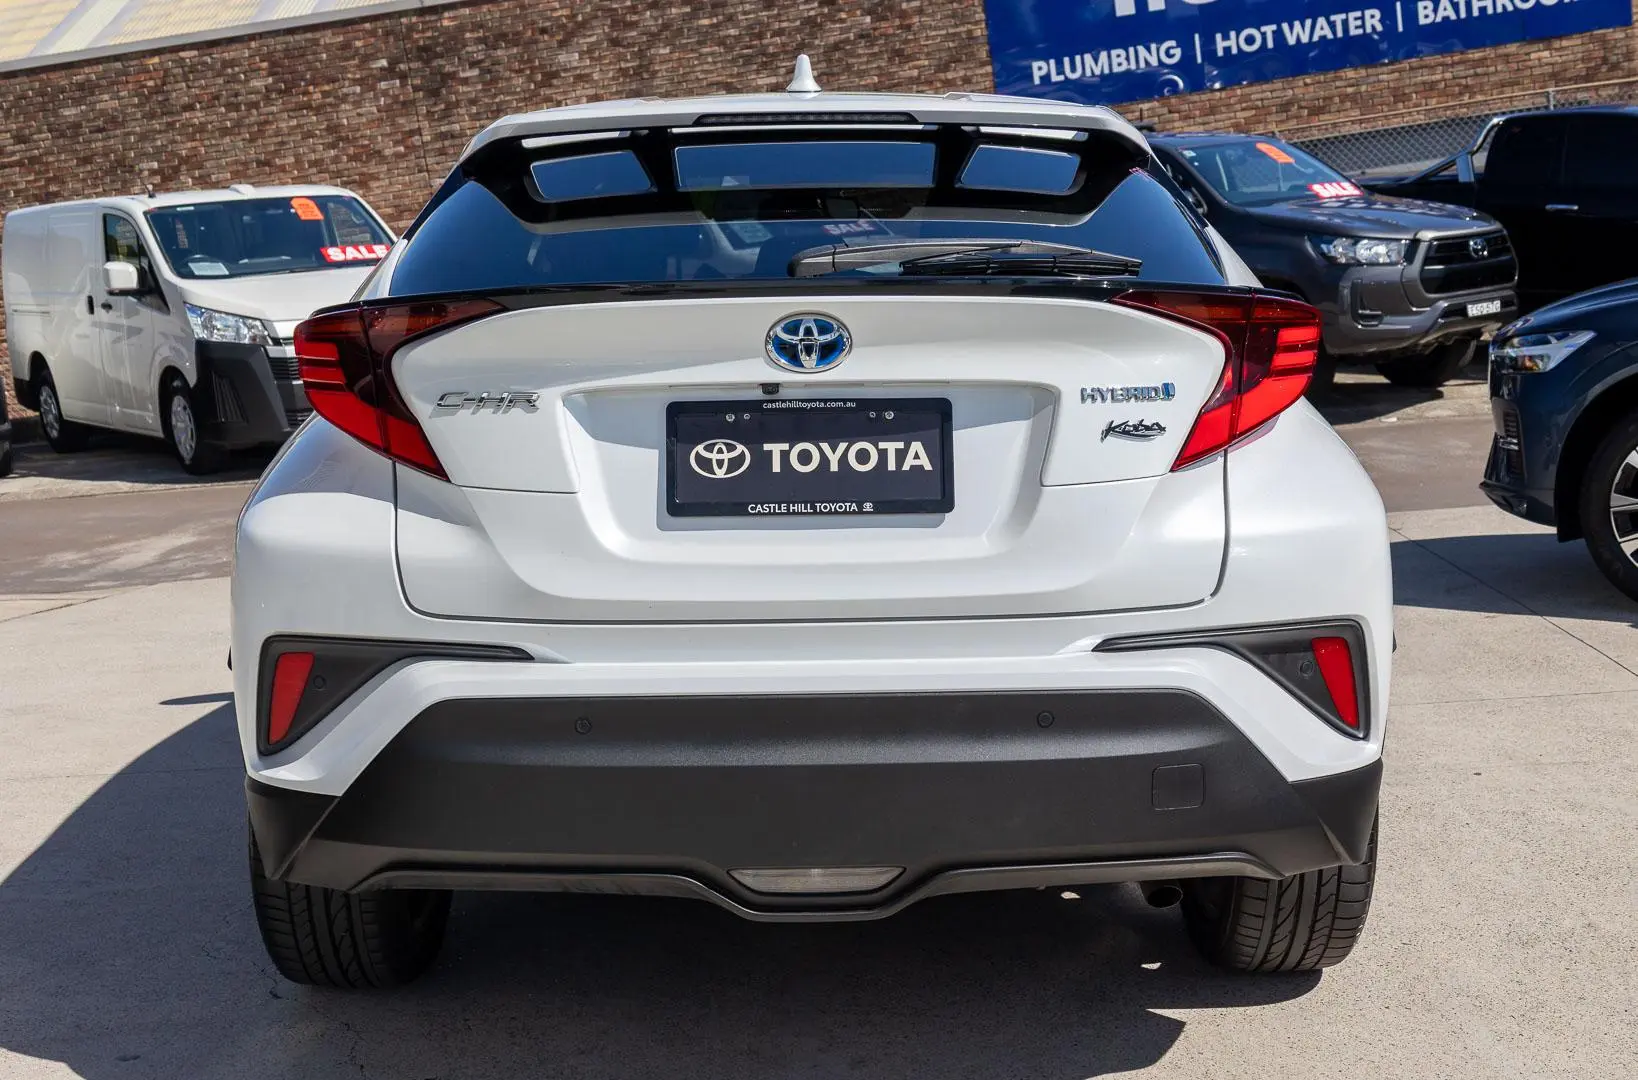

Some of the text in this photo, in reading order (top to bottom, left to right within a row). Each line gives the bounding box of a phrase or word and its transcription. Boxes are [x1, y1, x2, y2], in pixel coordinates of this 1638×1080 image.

[1031, 40, 1182, 85] PLUMBING
[1215, 24, 1277, 57] HOT
[1281, 8, 1383, 46] WATER
[824, 219, 874, 236] SALE
[326, 244, 388, 262] SALE
[436, 391, 540, 410] C-HR
[1080, 385, 1161, 404] HYBRID
[762, 400, 857, 410] castlehilltoyota.com.au
[763, 441, 934, 473] TOYOTA
[747, 502, 859, 513] CASTLE HILL TOYOTA
